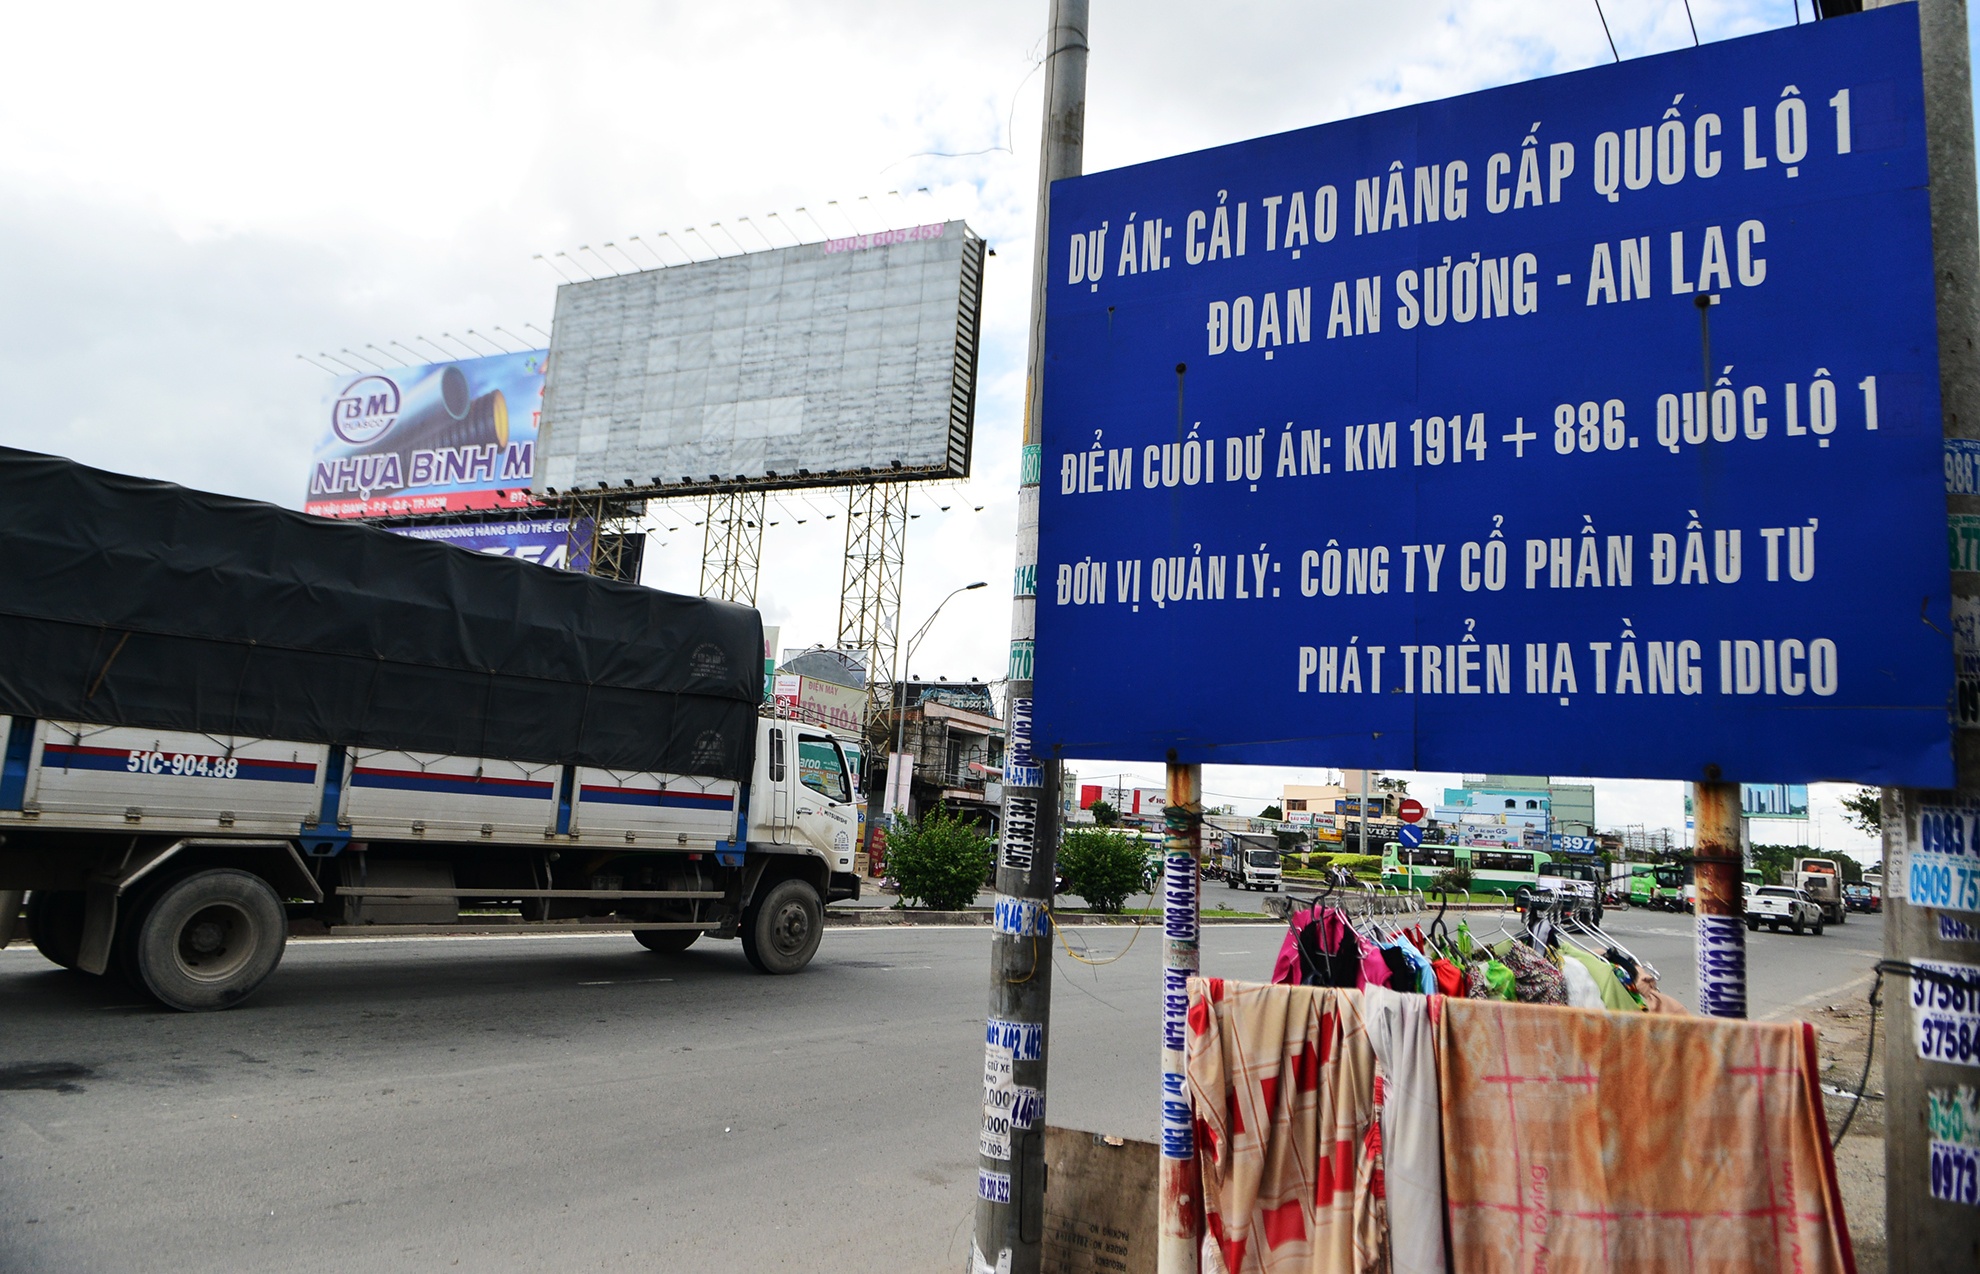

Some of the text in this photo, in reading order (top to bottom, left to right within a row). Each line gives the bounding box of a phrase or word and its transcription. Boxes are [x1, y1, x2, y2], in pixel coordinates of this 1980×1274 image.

[1069, 85, 1850, 292] DỰ ÁN: CẢI TẠO NÂNG CẤP QUỐC LỘ 1
[1207, 220, 1766, 359] ĐOẠN AN SƯƠNG - AN LẠC
[1061, 366, 1877, 494] ĐIỂM CUỐI DỰ ÁN: KM 1914 + 886. QUỐC LỘ 1
[1057, 510, 1818, 612] ĐƠN VỊ QUẢN LÝ: CÔNG TY CỔ PHẦN ĐẦU TƯ
[1299, 618, 1837, 705] PHÁT TRIỂN HẠ TẦNG IDICO
[127, 750, 239, 779] 51C-904.88
[1560, 836, 1594, 850] 897
[1165, 857, 1196, 939] 0908.46.44.46
[1911, 863, 1980, 910] 0909.75
[1530, 1164, 1549, 1235] loving
